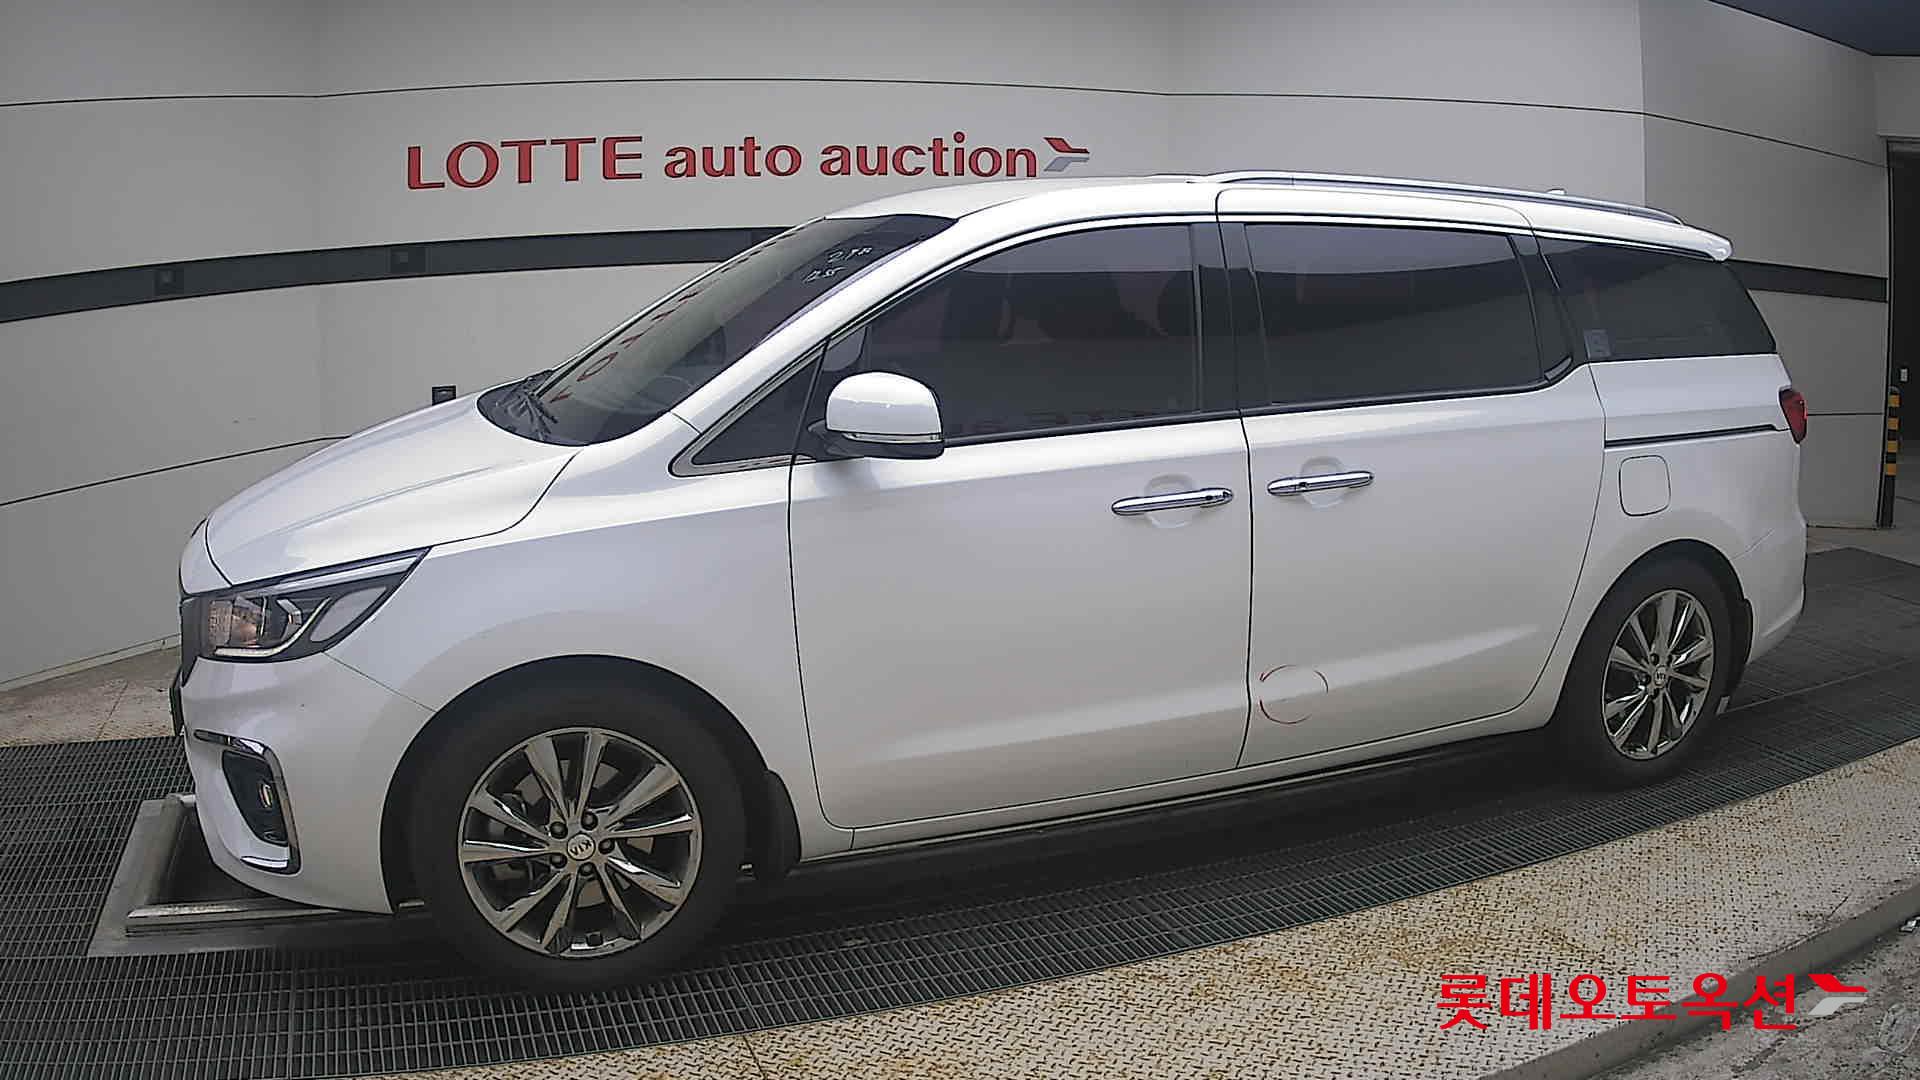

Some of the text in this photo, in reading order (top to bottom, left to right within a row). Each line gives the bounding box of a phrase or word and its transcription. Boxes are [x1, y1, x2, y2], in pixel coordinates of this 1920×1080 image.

[407, 132, 1038, 190] LOTTE auto auction
